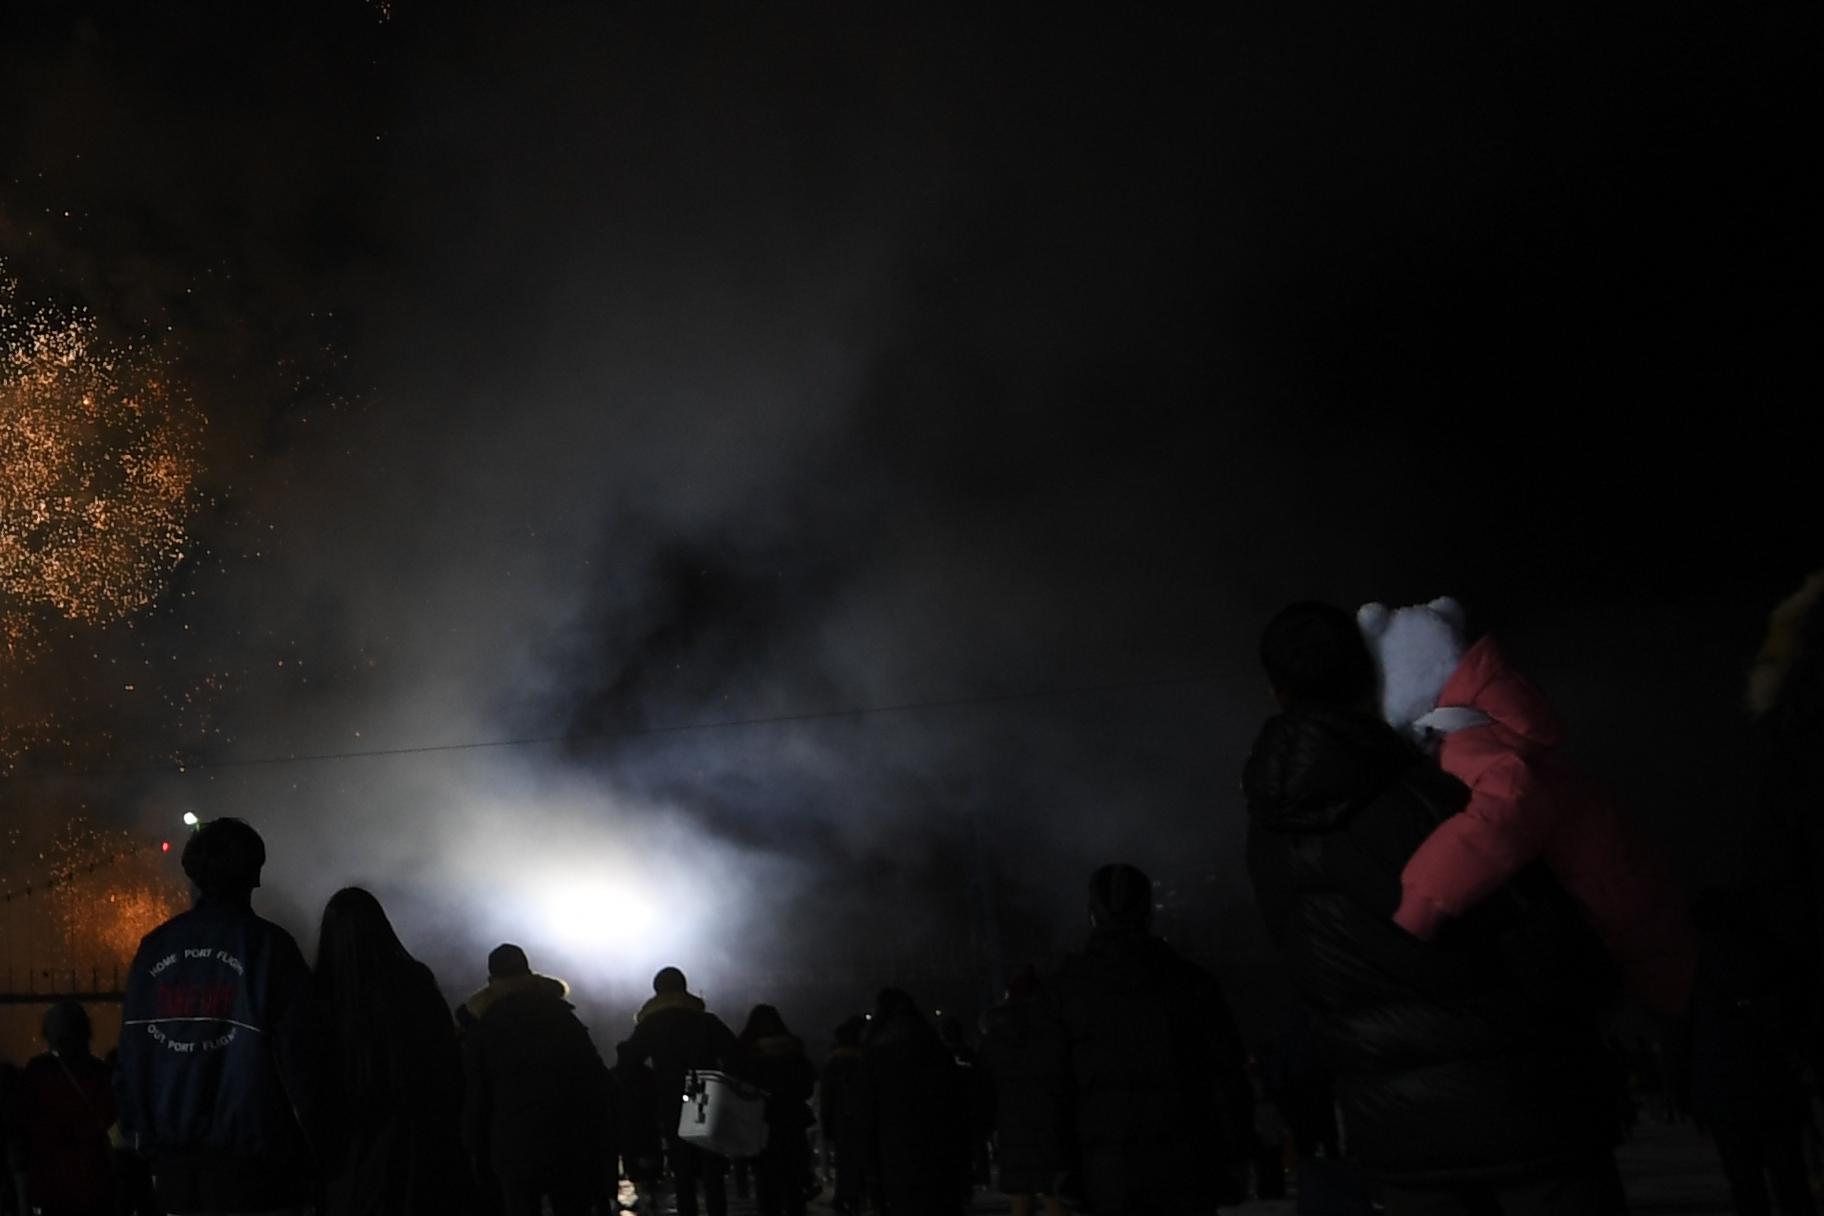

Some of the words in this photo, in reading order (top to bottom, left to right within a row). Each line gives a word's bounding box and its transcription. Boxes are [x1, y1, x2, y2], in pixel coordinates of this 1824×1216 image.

[149, 954, 177, 977] HOME
[184, 948, 212, 959] PORT
[147, 1024, 166, 1043] OUT
[168, 1039, 194, 1052] PORT
